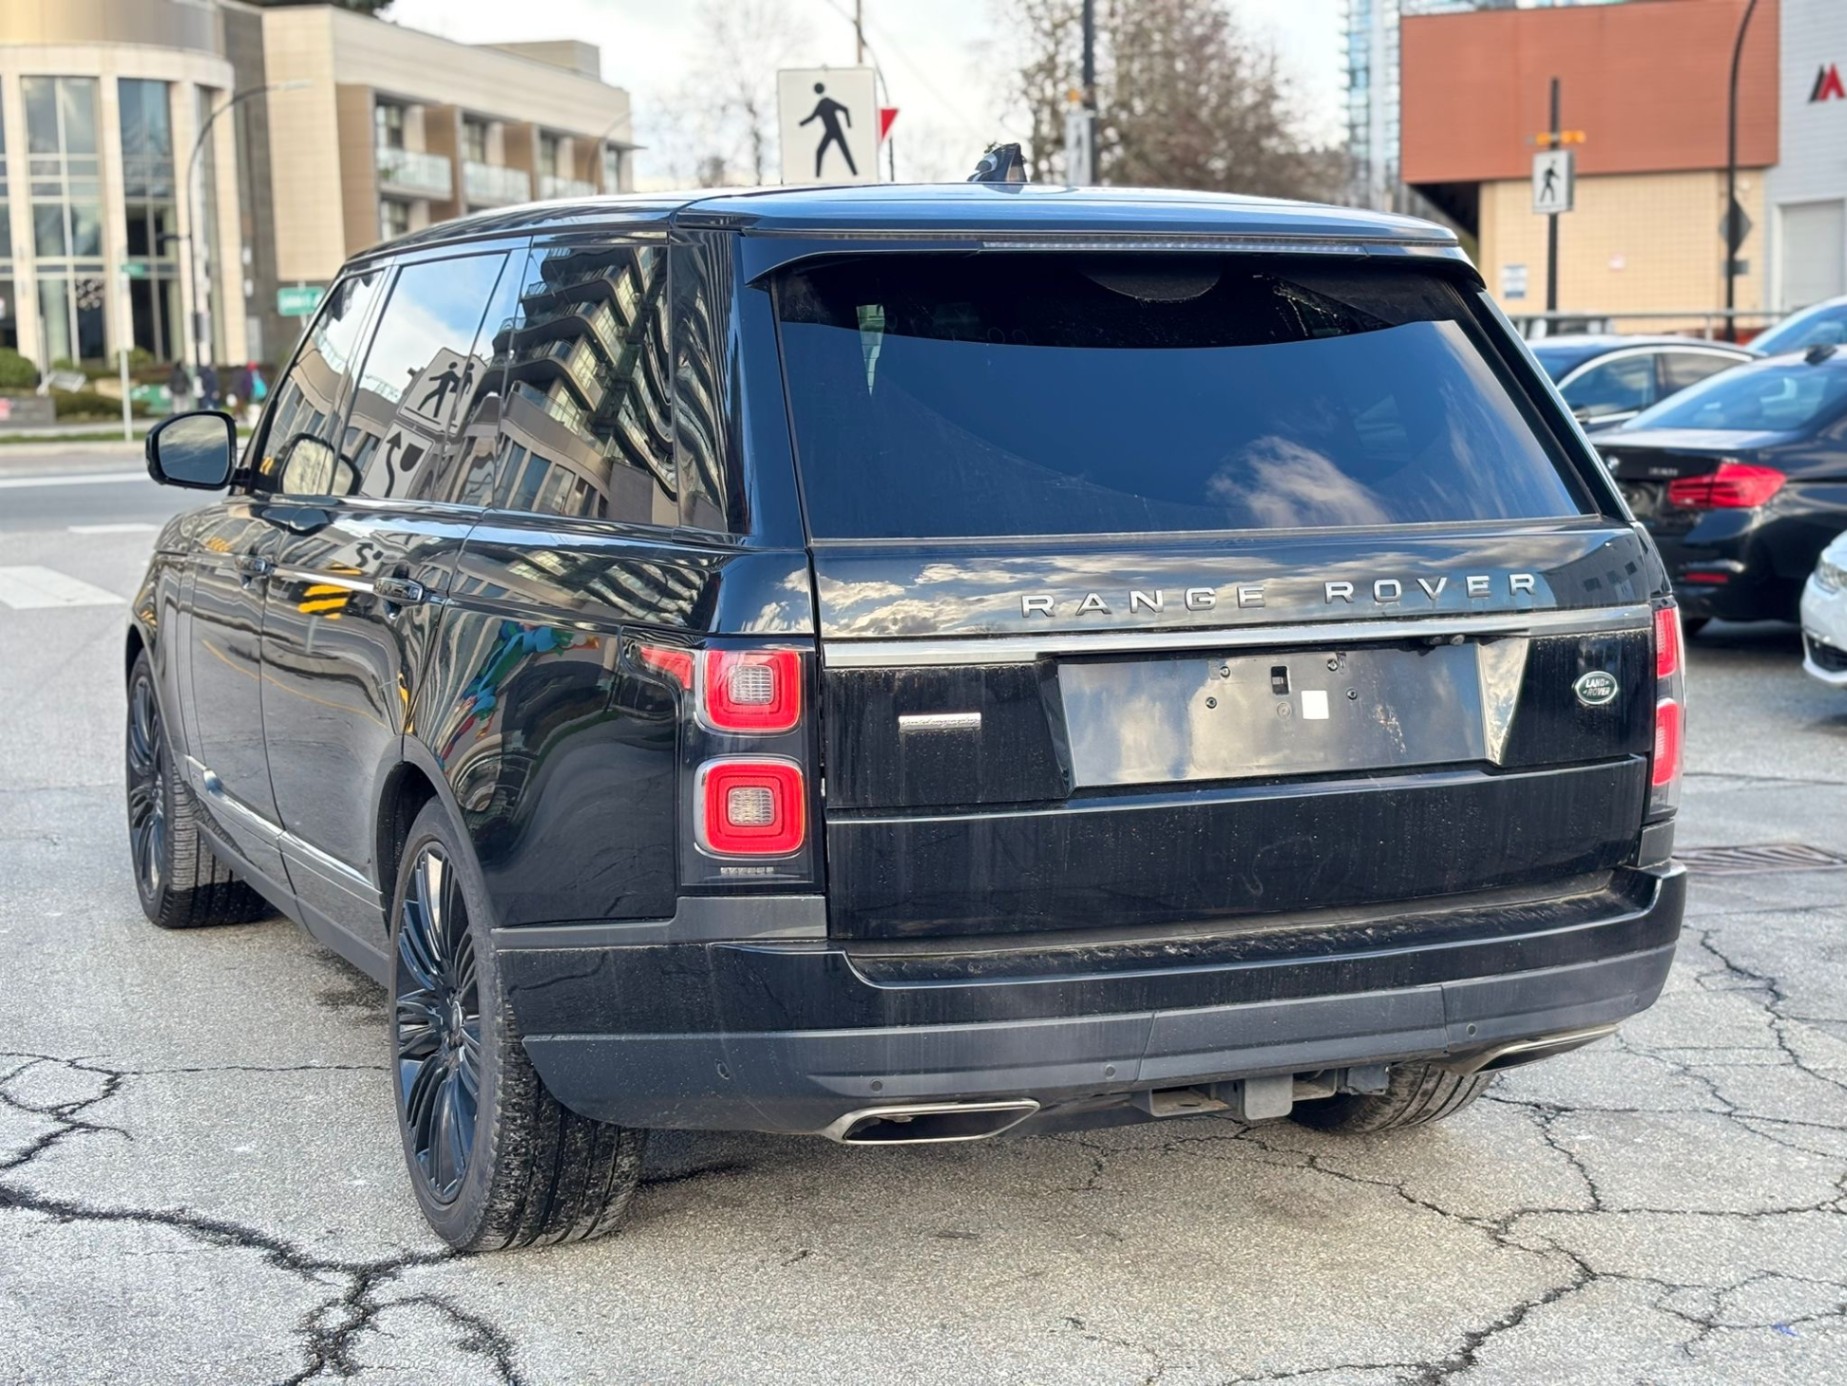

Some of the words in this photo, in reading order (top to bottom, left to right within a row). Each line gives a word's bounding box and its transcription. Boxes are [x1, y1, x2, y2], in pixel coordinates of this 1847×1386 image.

[1021, 586, 1266, 618] RANGE
[1324, 573, 1537, 604] ROVER
[1585, 678, 1605, 688] LAND
